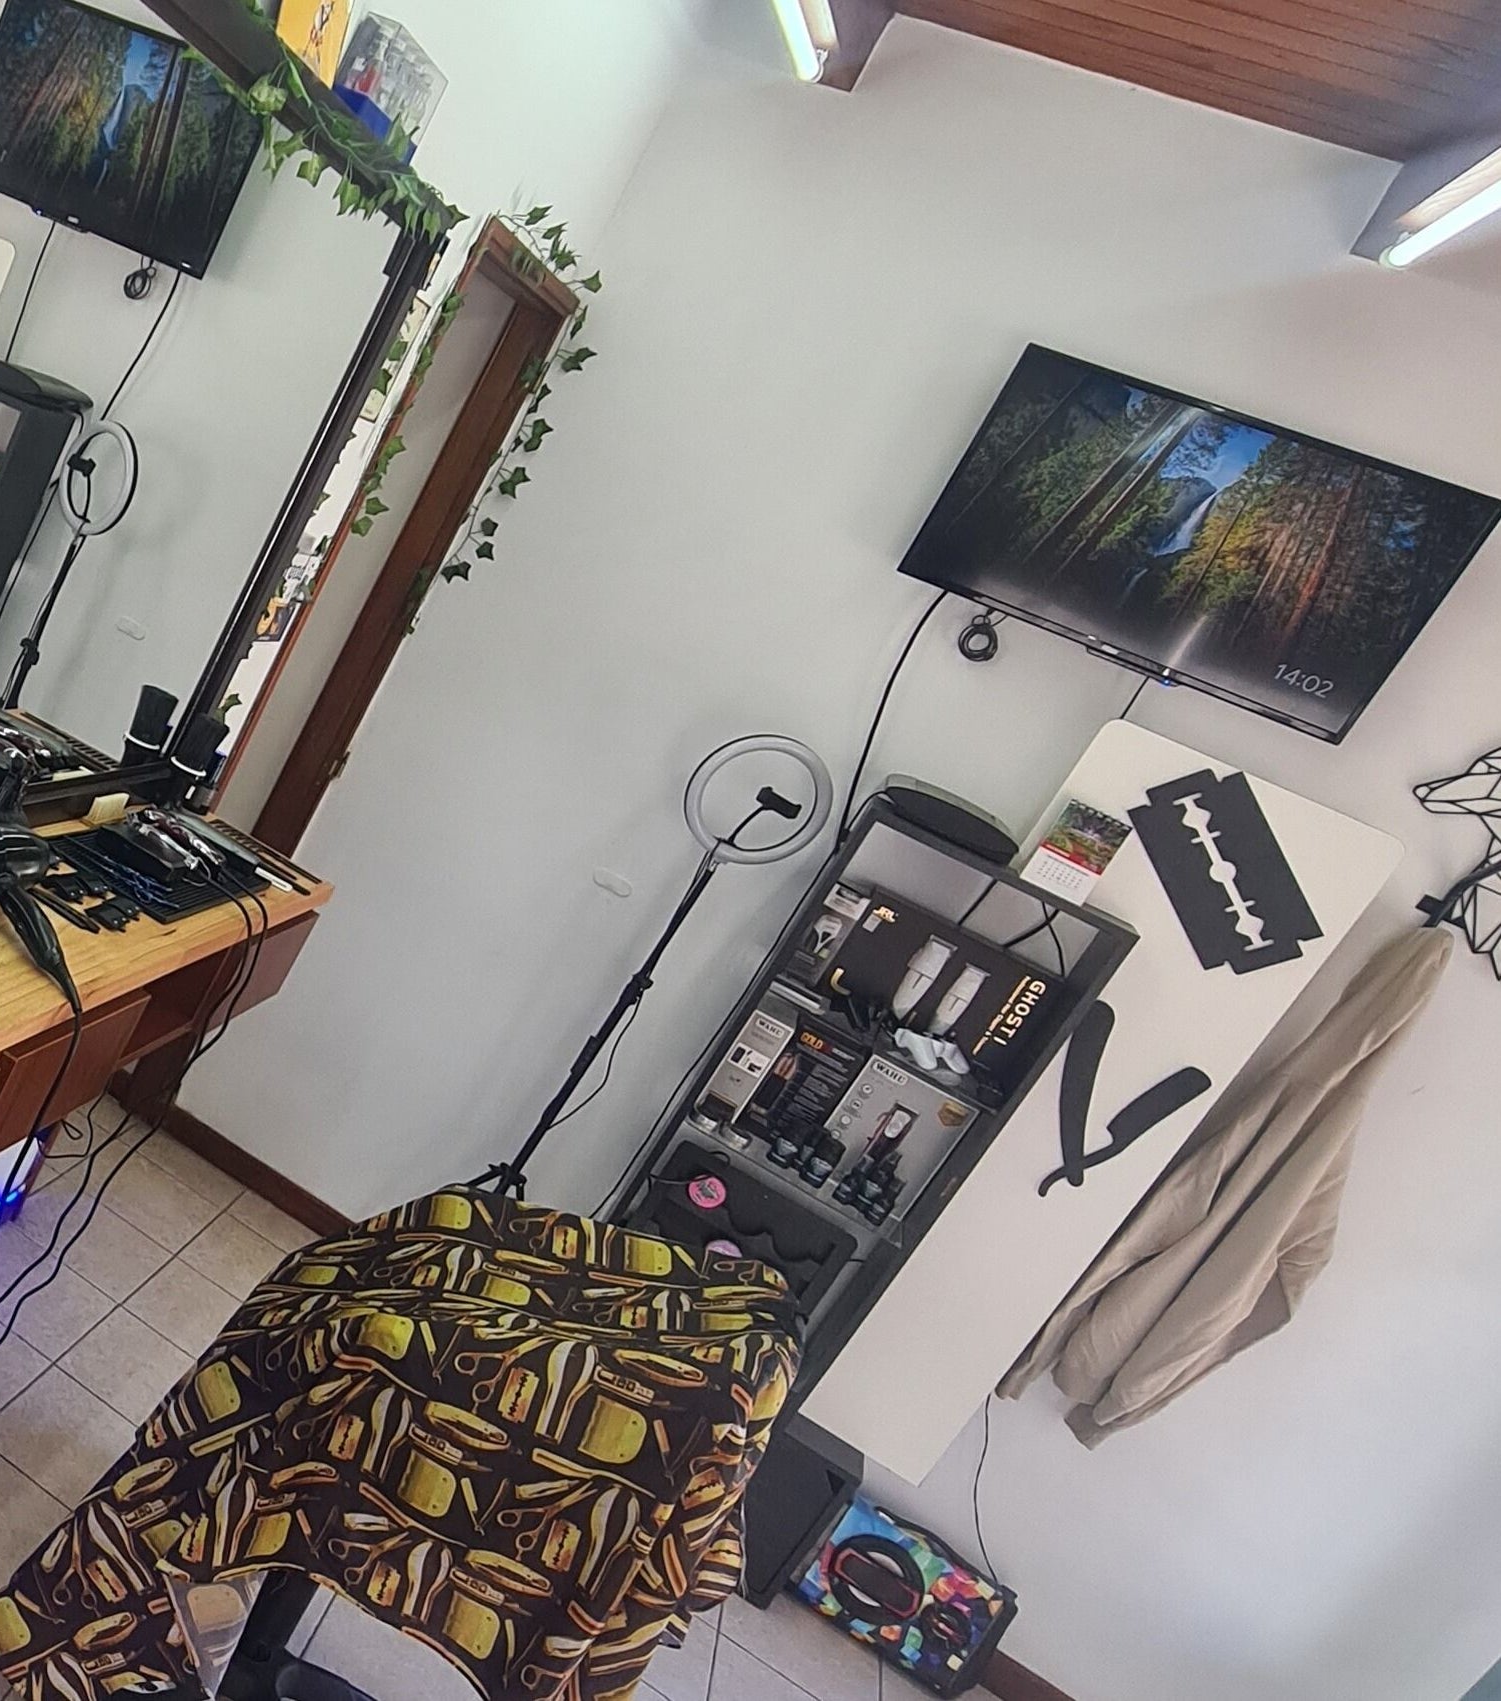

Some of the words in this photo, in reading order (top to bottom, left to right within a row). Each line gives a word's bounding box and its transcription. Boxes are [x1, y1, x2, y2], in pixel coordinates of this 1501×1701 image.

[1274, 664, 1334, 698] 14:02
[872, 906, 896, 923] JRL
[1000, 980, 1046, 1038] GHOST
[875, 1062, 906, 1084] WAHL
